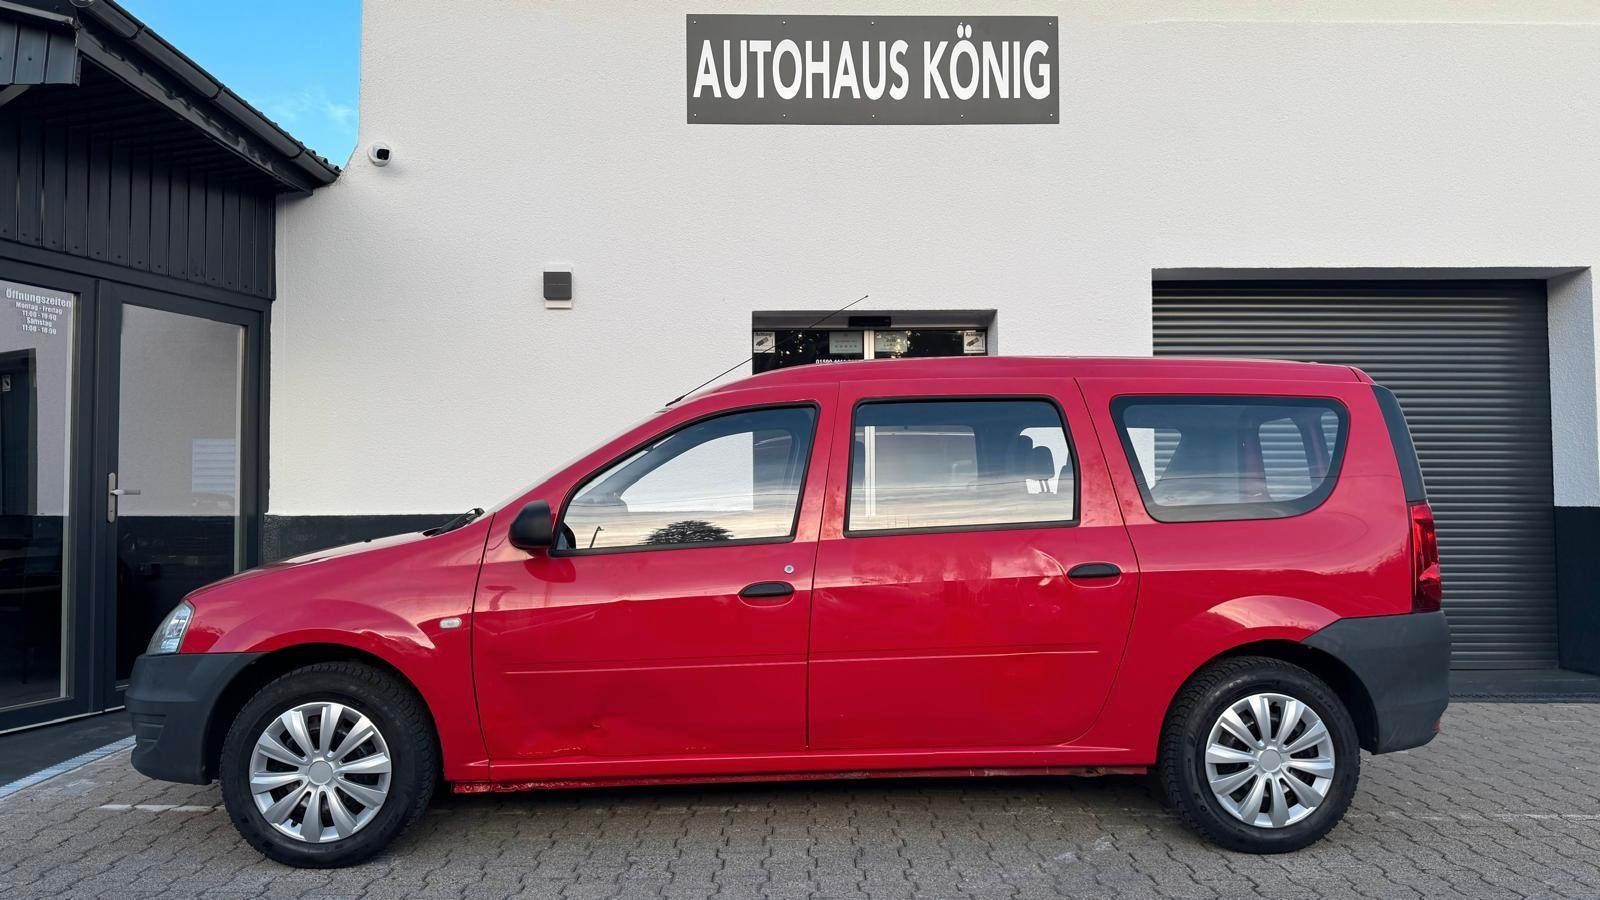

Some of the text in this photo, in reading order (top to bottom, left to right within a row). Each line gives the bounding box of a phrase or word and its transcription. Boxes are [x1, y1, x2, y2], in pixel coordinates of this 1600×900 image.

[693, 24, 1051, 100] AUTOHAUS KÖNIG
[6, 287, 71, 308] Öffnungszeiten
[16, 302, 38, 311] Montag
[43, 305, 63, 315] Freitag
[26, 317, 52, 327] Samstag
